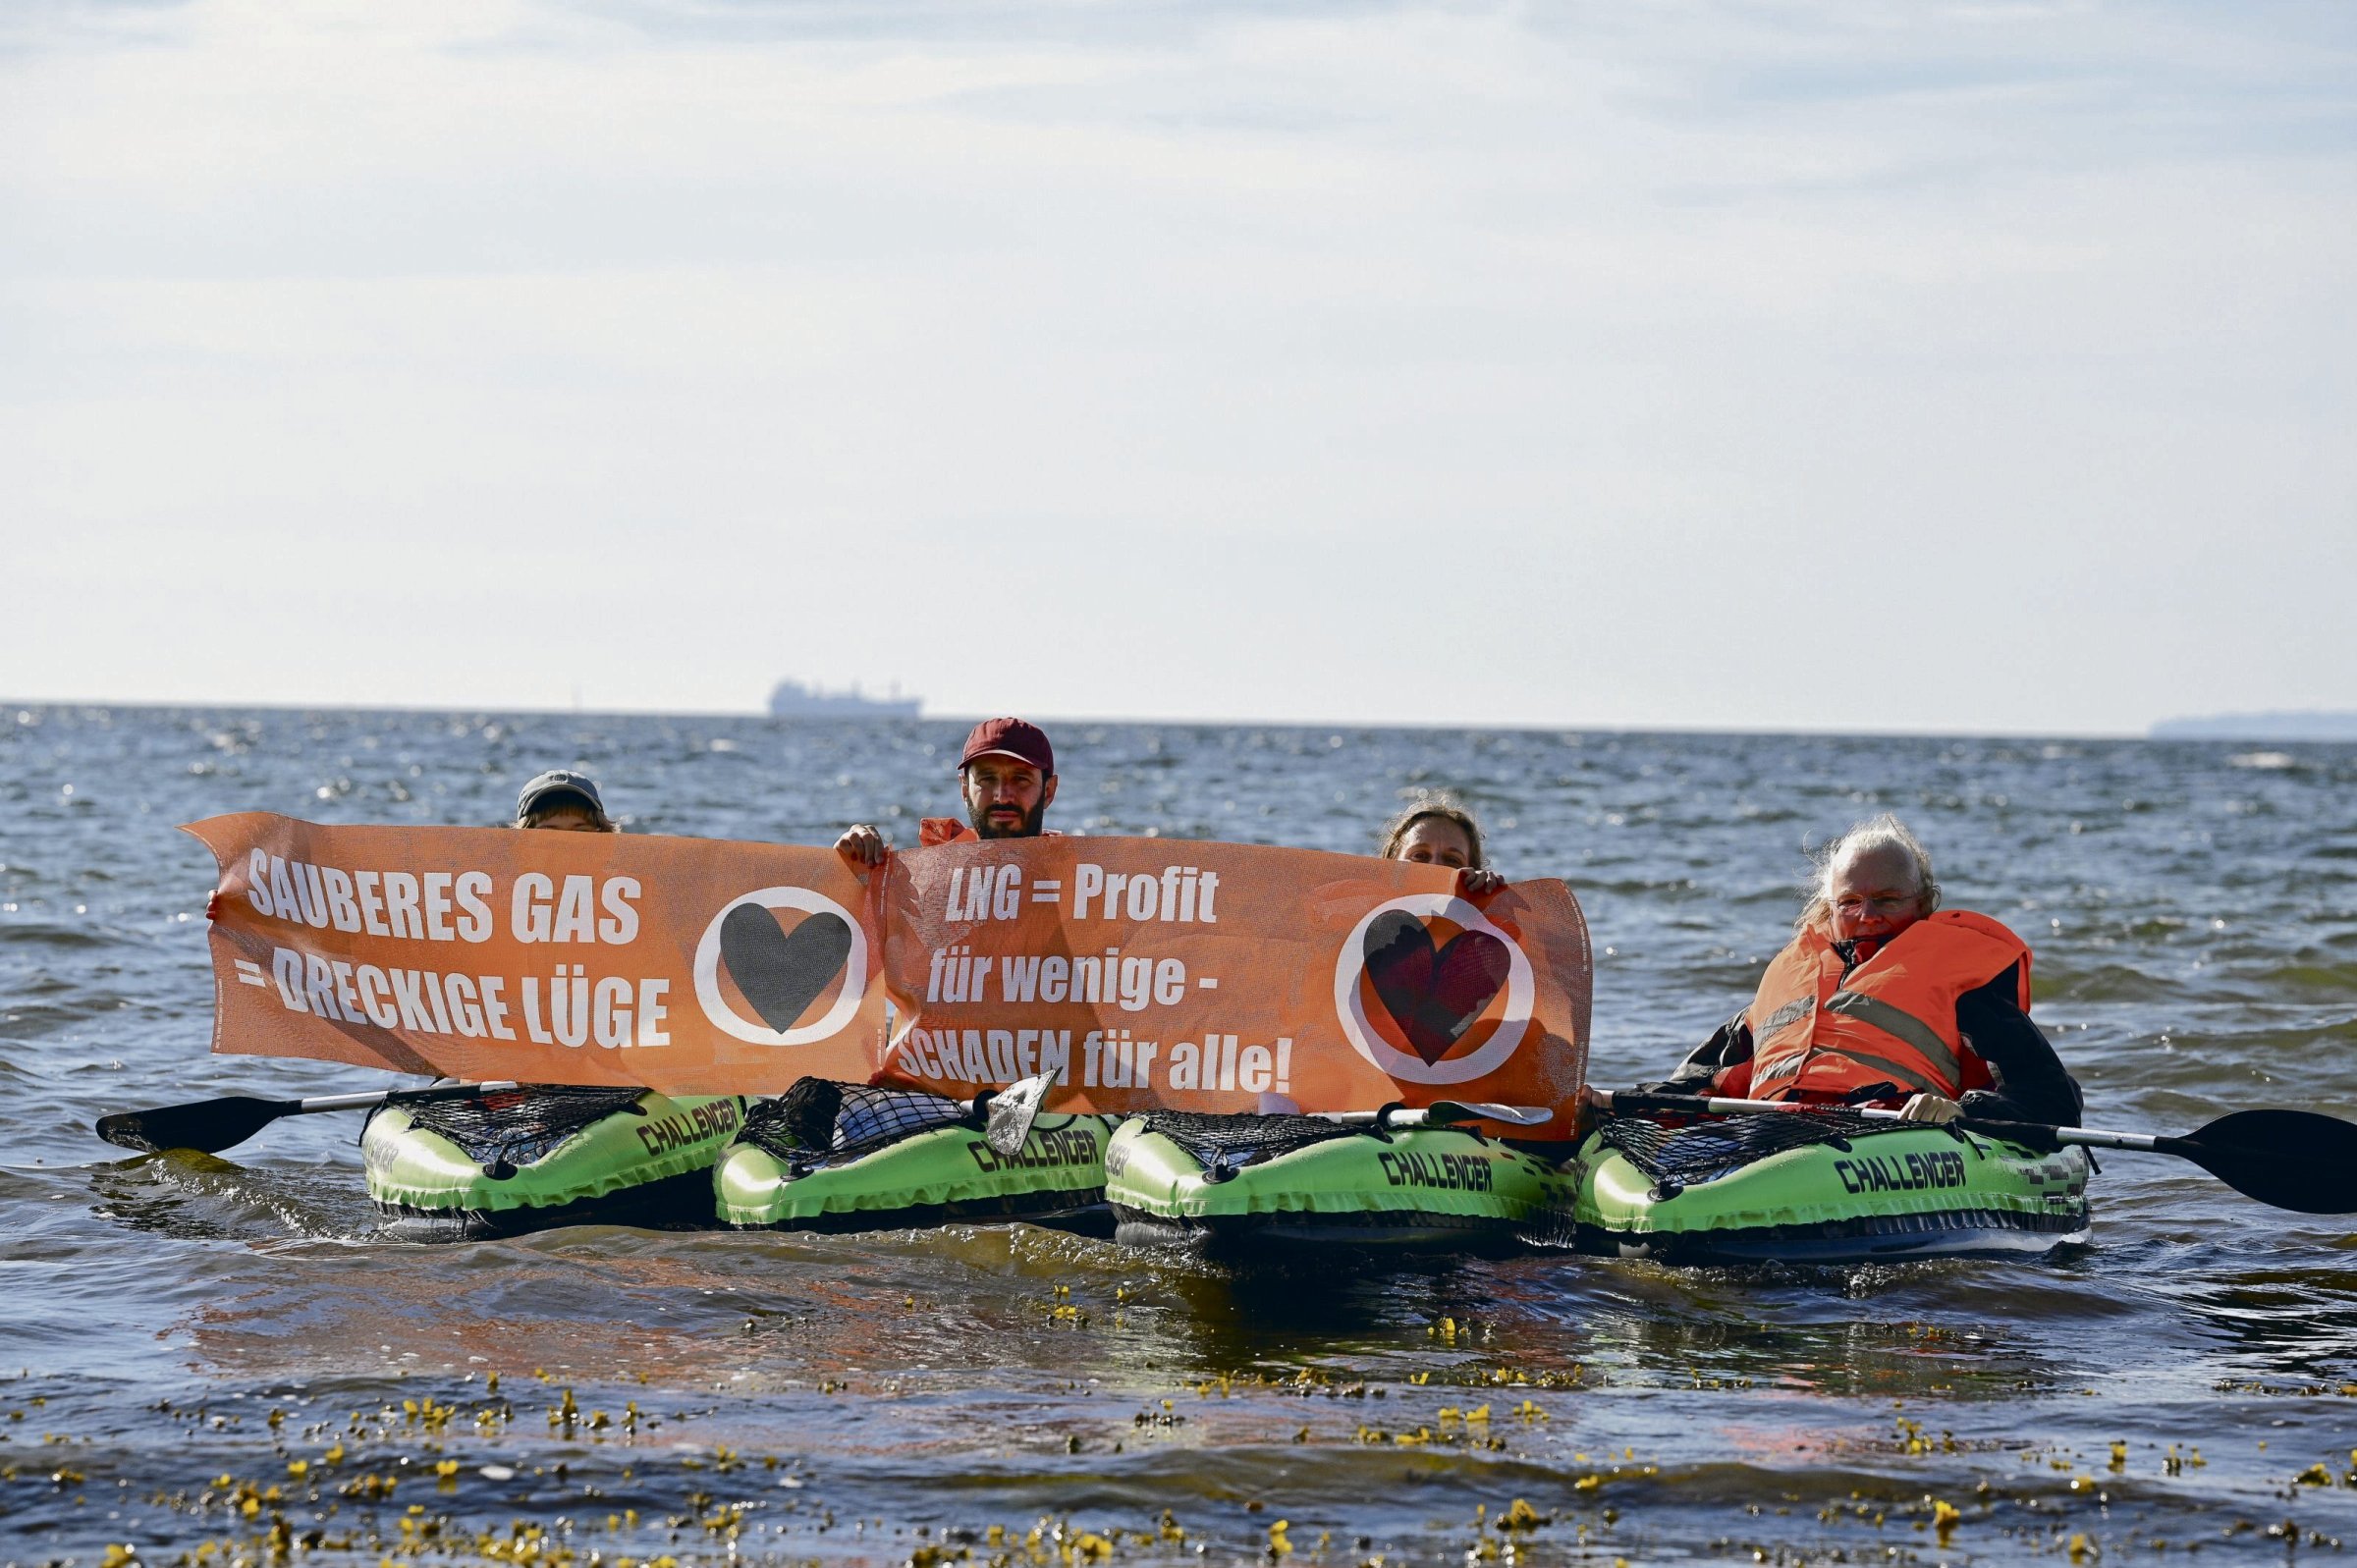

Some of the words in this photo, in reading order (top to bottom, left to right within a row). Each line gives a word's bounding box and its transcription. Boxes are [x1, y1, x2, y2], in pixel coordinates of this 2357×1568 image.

[247, 847, 493, 944] SAUBERES
[511, 872, 641, 946] GAS
[945, 864, 1022, 921] LNG
[1032, 880, 1062, 902] =
[1073, 864, 1220, 923] Profit
[234, 958, 266, 988] =
[272, 946, 518, 1041] DRECKIGE
[521, 963, 671, 1049] LÜGE
[926, 946, 992, 1002] für
[1002, 947, 1186, 1011] wenige
[1198, 978, 1218, 989] -
[898, 1028, 1071, 1087] SCHADEN
[1083, 1029, 1157, 1088] für
[1169, 1034, 1293, 1094] alle!
[636, 1098, 739, 1157] CHALLENGER
[1377, 1151, 1493, 1193] CHALLENGER
[1834, 1151, 1967, 1194] CHALLENGER
